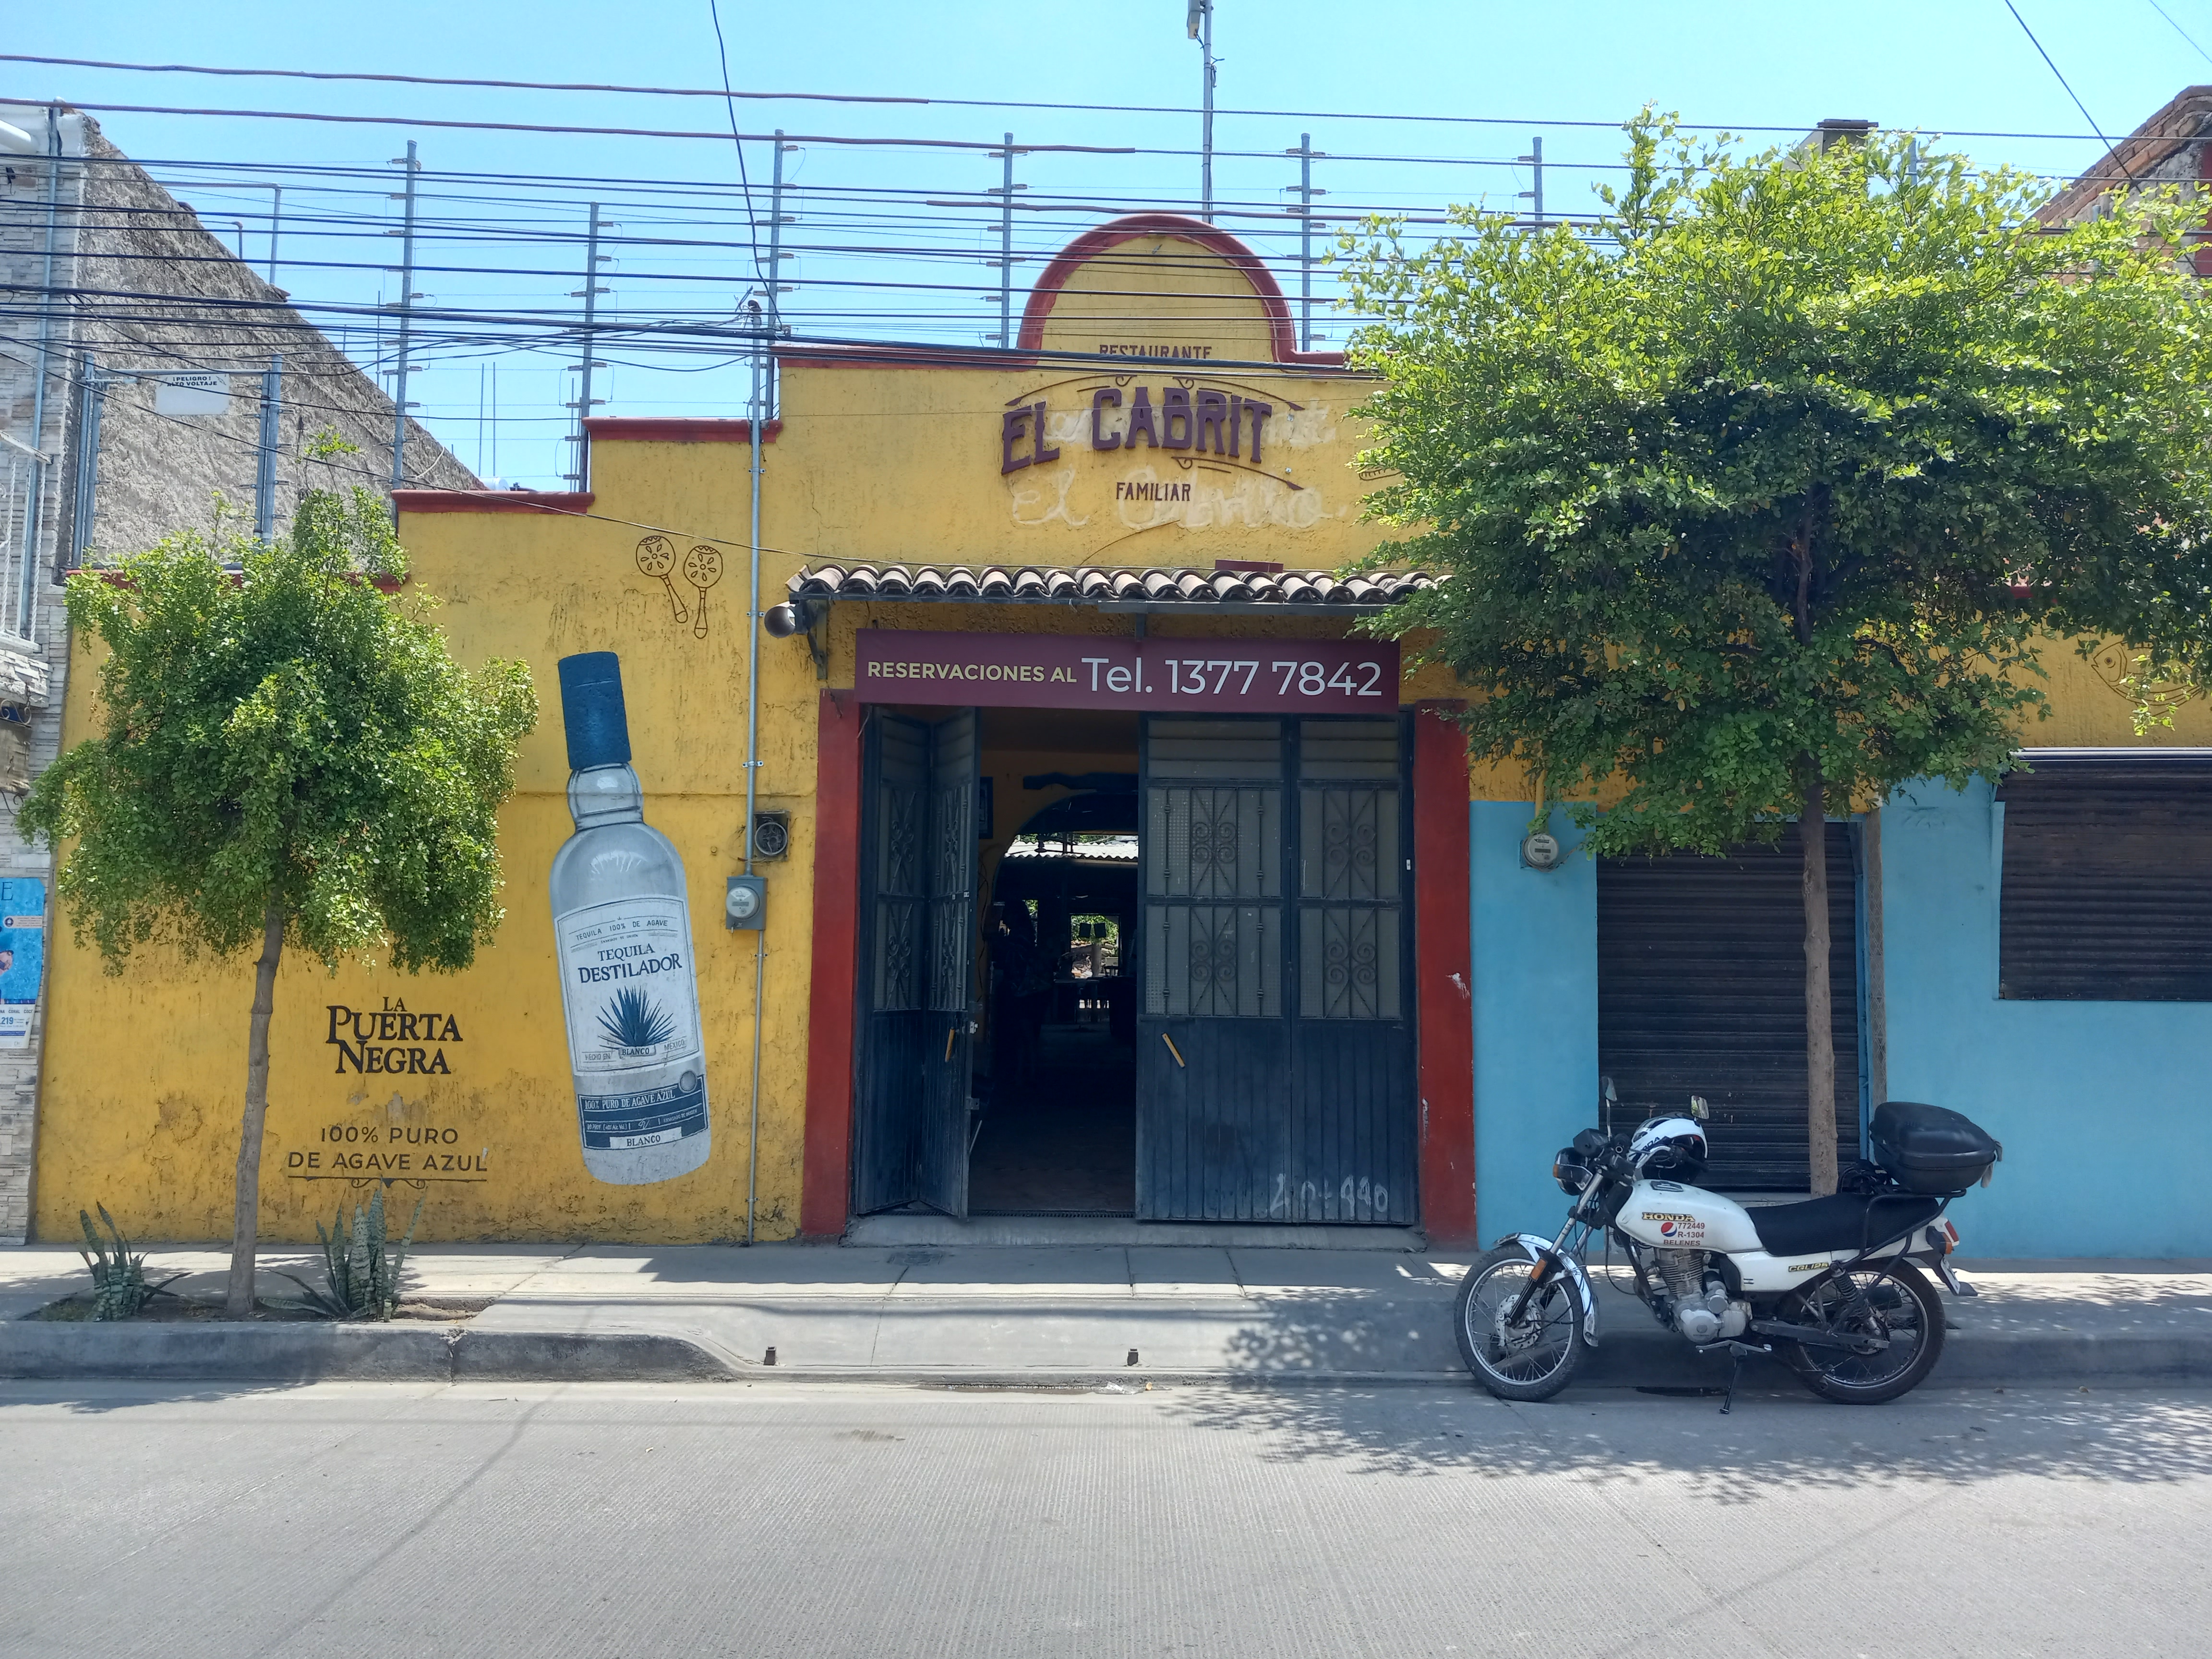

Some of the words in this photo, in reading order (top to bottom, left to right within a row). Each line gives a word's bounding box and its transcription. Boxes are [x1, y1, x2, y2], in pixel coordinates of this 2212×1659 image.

[1001, 401, 1060, 475] EL
[1091, 387, 1272, 463] CABRIT
[1116, 482, 1191, 502] FAMILIAR
[867, 661, 1045, 683] RESERVACIONES
[1050, 666, 1077, 684] AL
[1081, 657, 1153, 693] Tel.
[1164, 659, 1261, 695] 1377
[1272, 661, 1382, 697] 7842
[576, 928, 602, 941] TEQUILA
[610, 923, 626, 931] 100%
[598, 943, 656, 962] TEQUILA
[578, 953, 682, 984] DESTILADOR
[383, 997, 407, 1012] LA
[325, 1005, 463, 1044] PUERTA
[335, 1039, 451, 1074] NEGRA
[622, 1047, 649, 1056] BLANCO
[585, 1100, 600, 1110] 100%
[602, 1099, 619, 1109] PURO
[621, 1098, 632, 1108] DE
[631, 1094, 656, 1106] AGAVE
[656, 1090, 675, 1102] AZUL
[321, 1126, 378, 1143] 100%
[389, 1127, 458, 1144] PURO
[626, 1135, 661, 1147] BLANCO
[288, 1152, 320, 1168] DE
[332, 1153, 411, 1171] AGAVE
[422, 1154, 488, 1172] AZUL
[1642, 1212, 1695, 1222] HONDA
